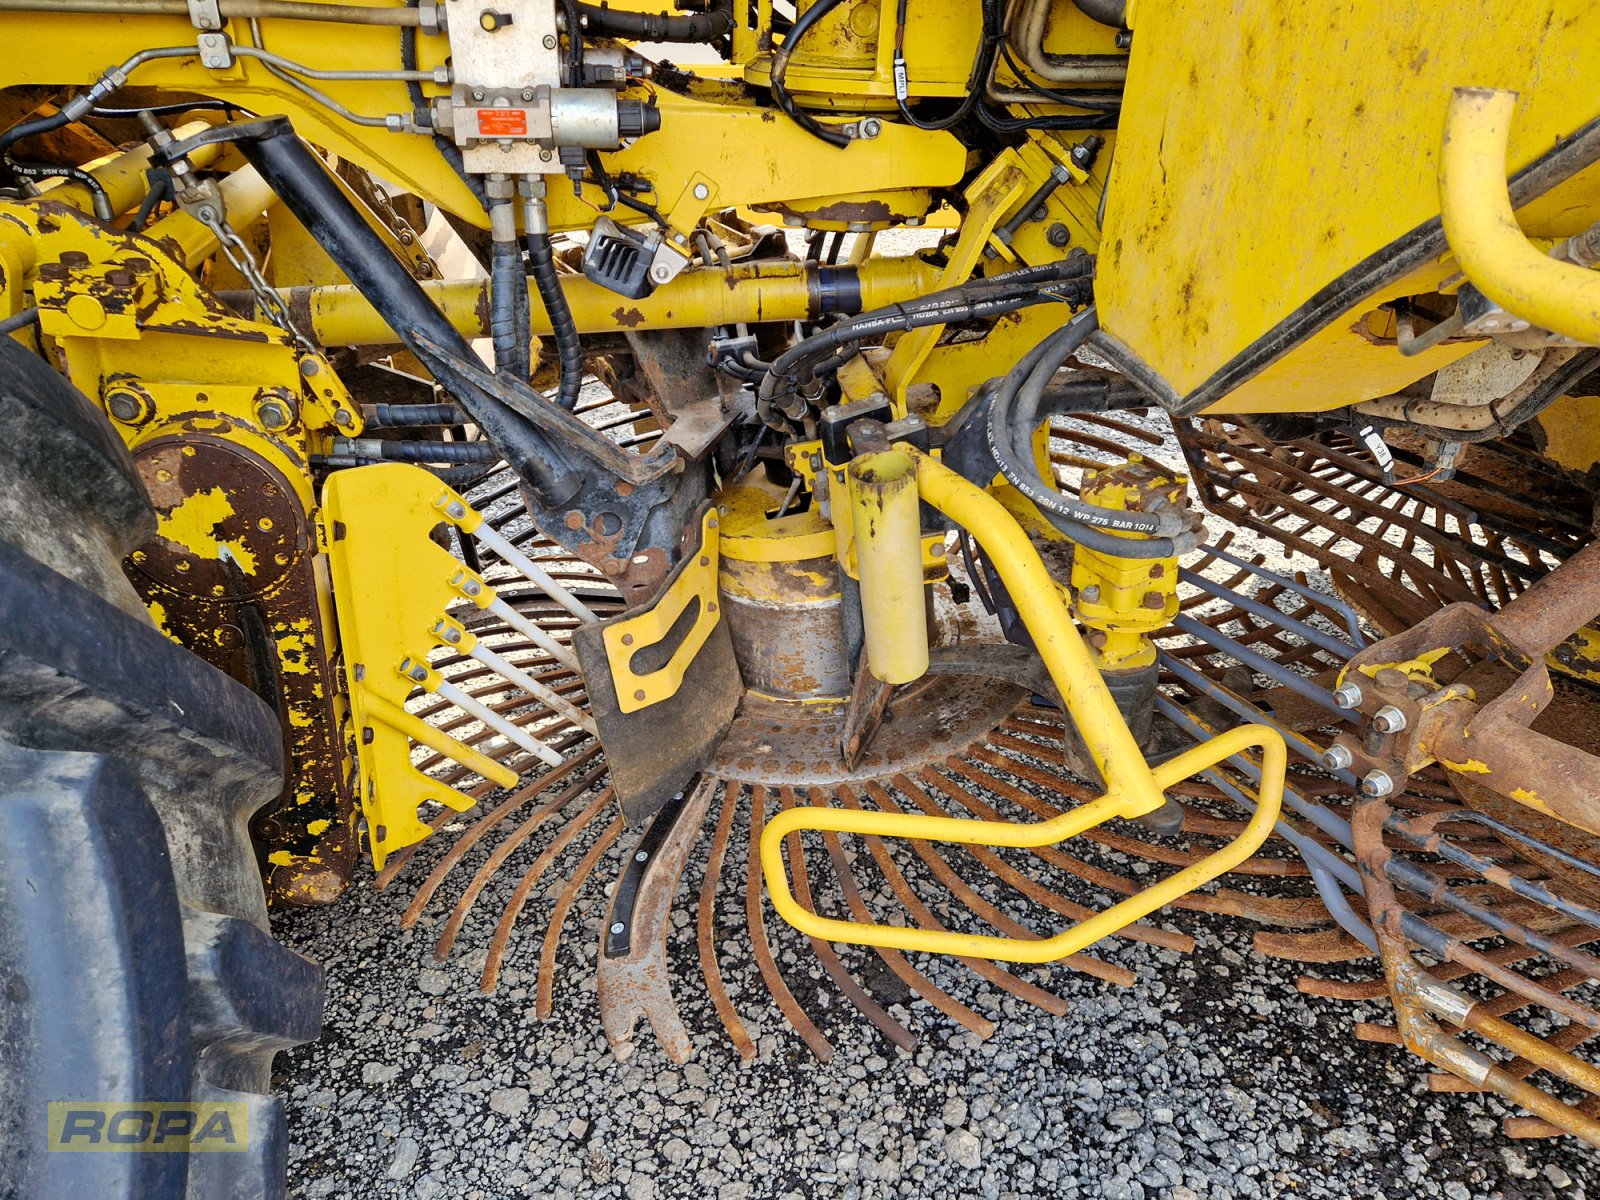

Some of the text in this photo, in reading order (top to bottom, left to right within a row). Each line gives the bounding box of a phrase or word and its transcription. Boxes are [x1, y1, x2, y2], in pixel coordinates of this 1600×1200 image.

[23, 167, 37, 175] 853
[990, 445, 1009, 472] HD213
[1008, 471, 1020, 485] EN
[1019, 482, 1035, 497] 853
[1037, 495, 1057, 509] 2SN
[1058, 505, 1070, 515] 12
[1073, 510, 1091, 521] WP
[1091, 516, 1109, 526] 275
[1112, 520, 1133, 530] BAR
